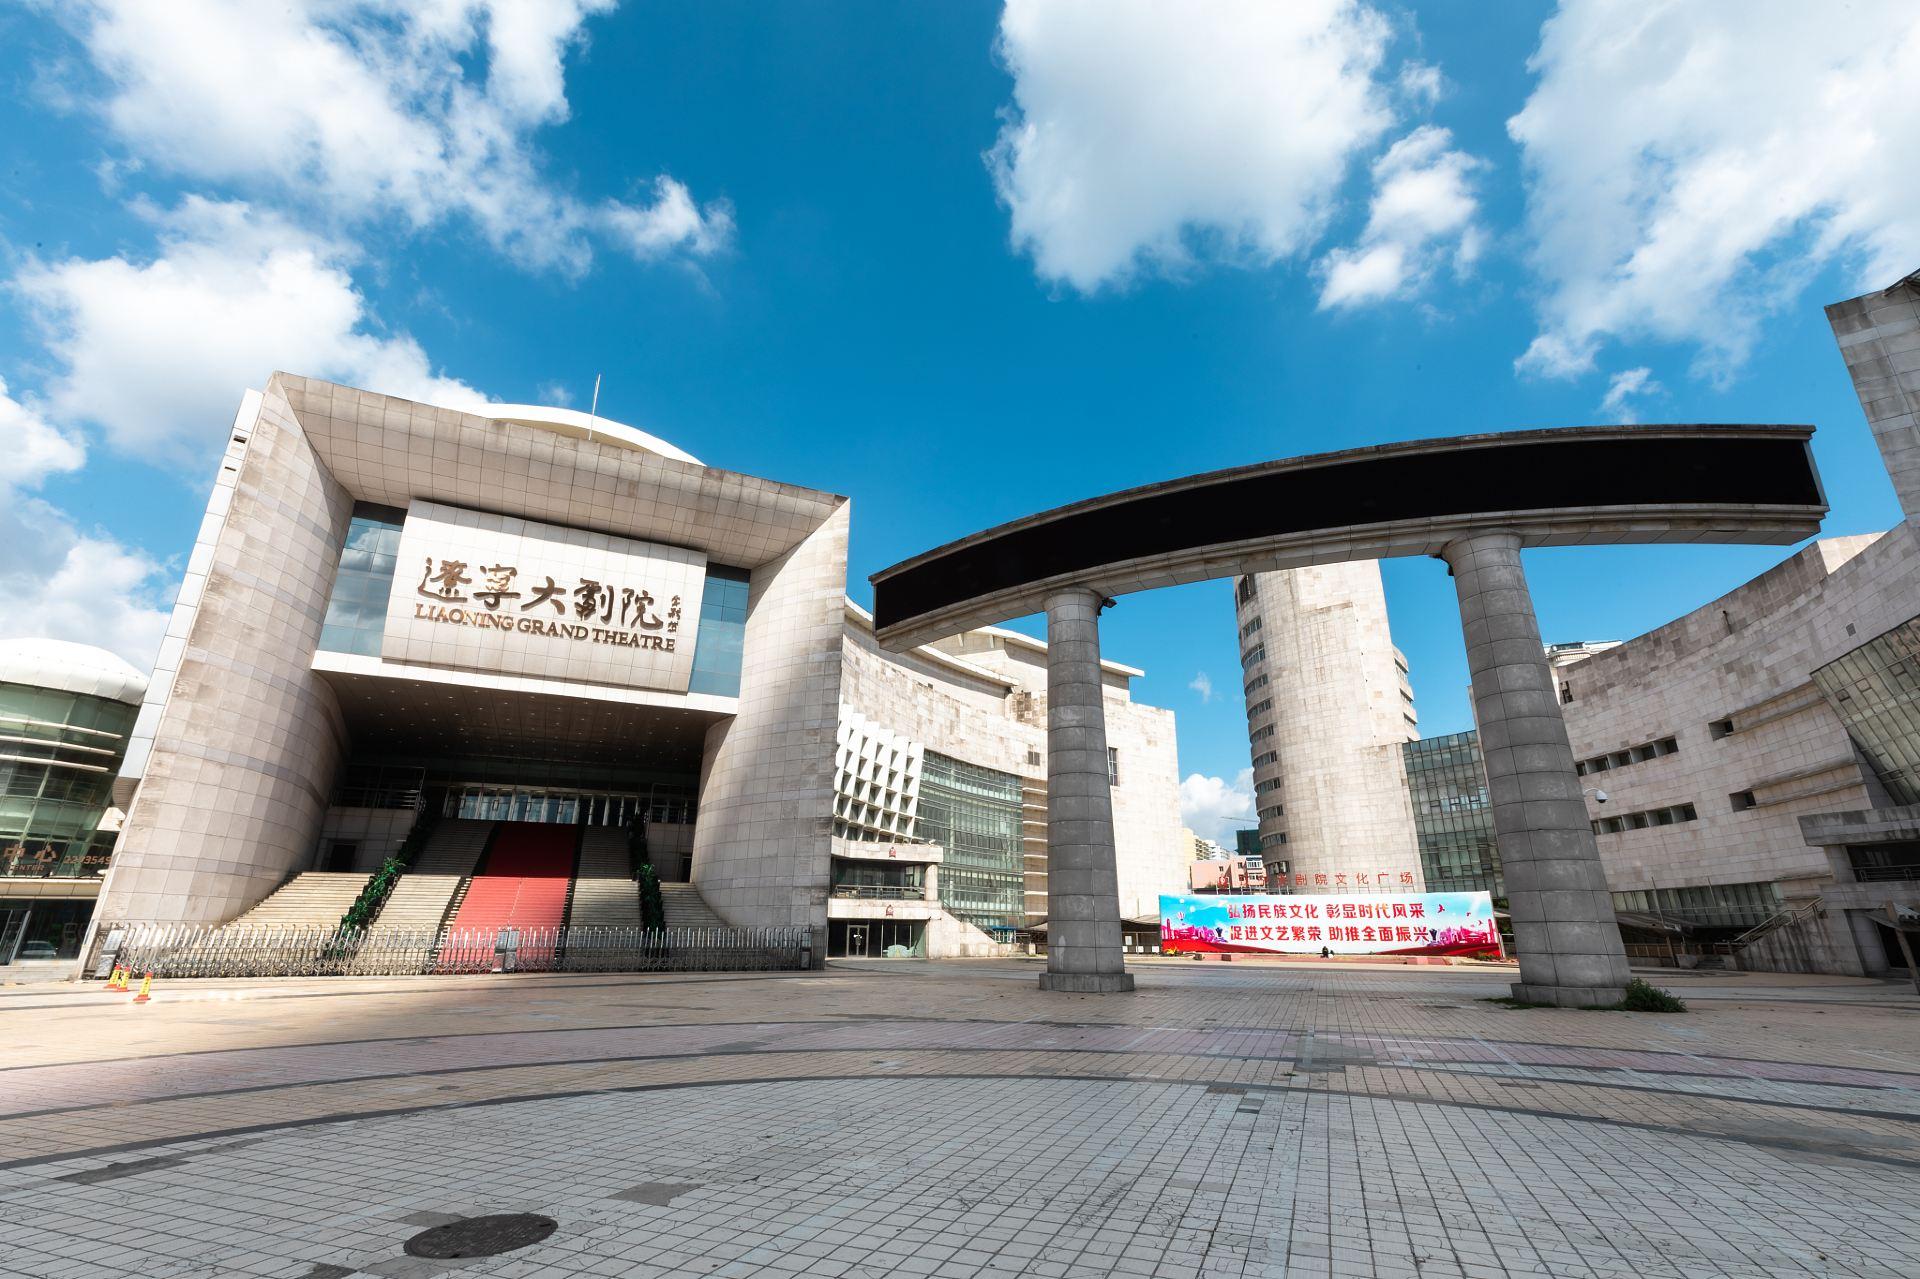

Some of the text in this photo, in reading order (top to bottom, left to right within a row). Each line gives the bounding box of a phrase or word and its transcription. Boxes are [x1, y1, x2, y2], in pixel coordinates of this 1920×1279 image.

[414, 603, 676, 653] LIAONING GRAND THEATRE
[1228, 903, 1425, 919] 弘扬民族文化 彰显时代风采
[1230, 925, 1430, 942] 促进文艺繁荣 助推全面振兴
